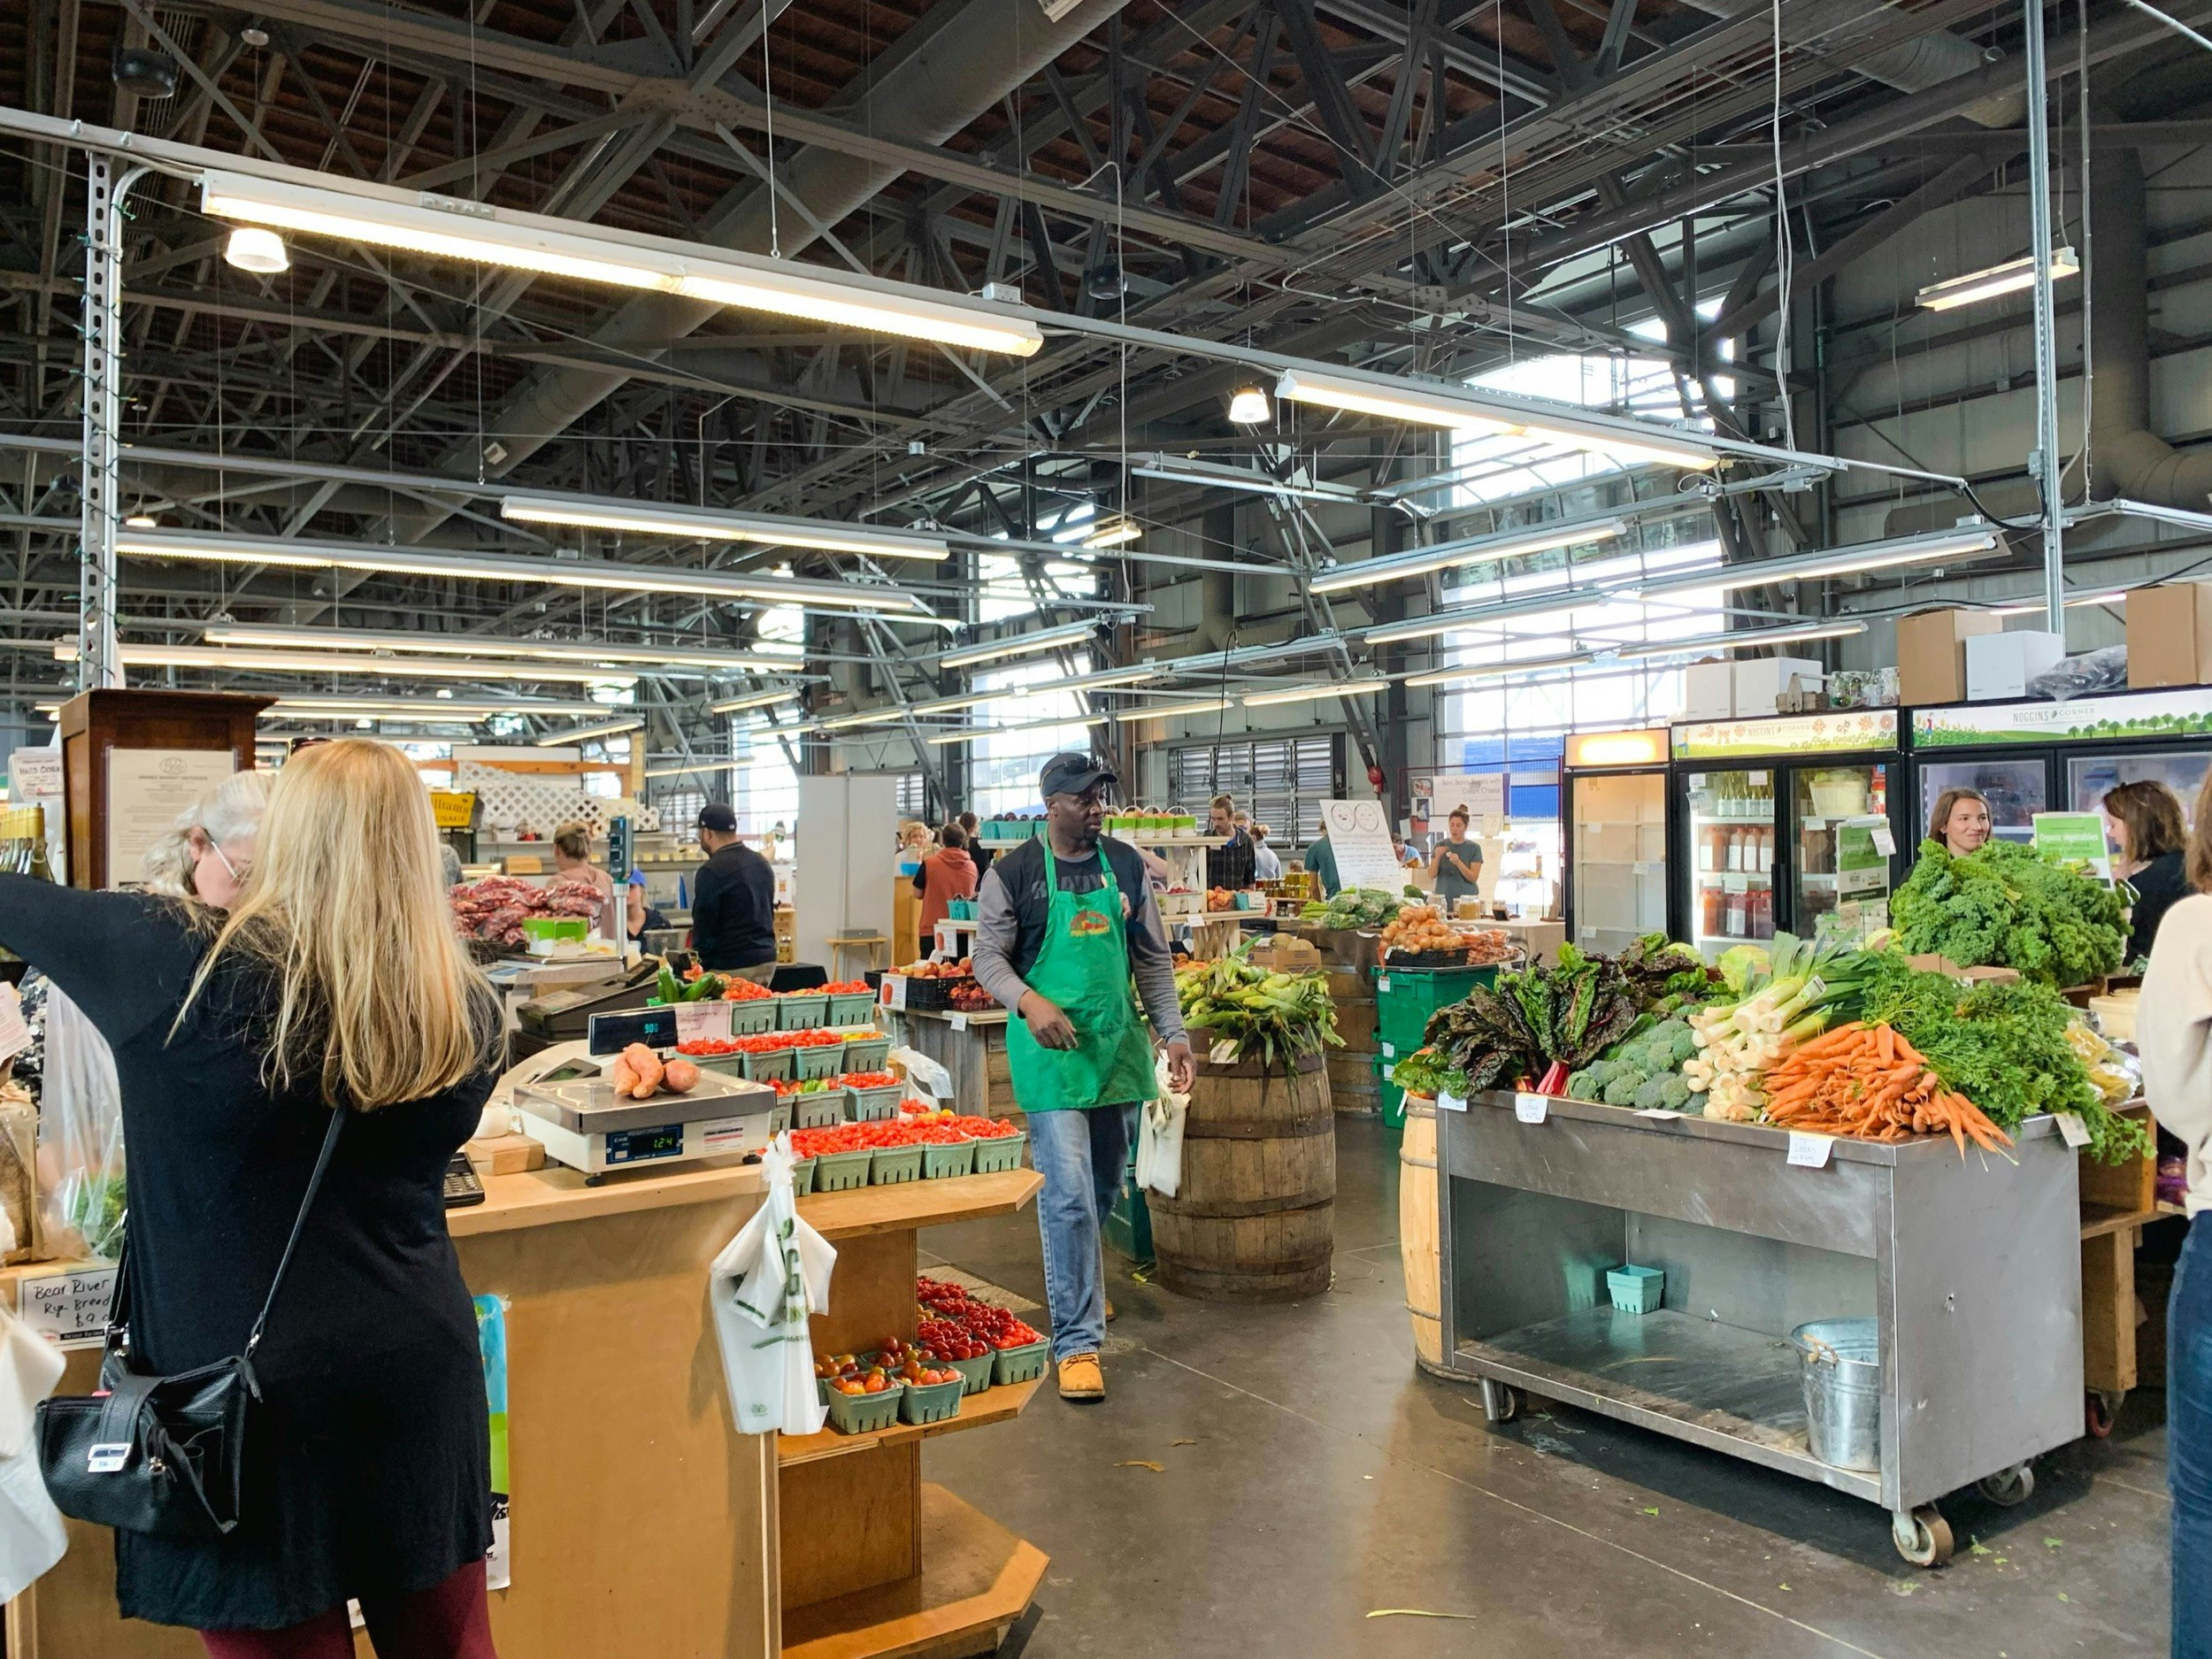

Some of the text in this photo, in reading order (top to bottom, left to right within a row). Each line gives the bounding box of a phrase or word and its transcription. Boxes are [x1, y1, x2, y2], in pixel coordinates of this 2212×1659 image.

[2013, 710, 2049, 723] NOGGINS
[1747, 727, 1775, 737] NOGGINS
[35, 1279, 110, 1300] Bear River
[74, 1294, 111, 1310] Bread
